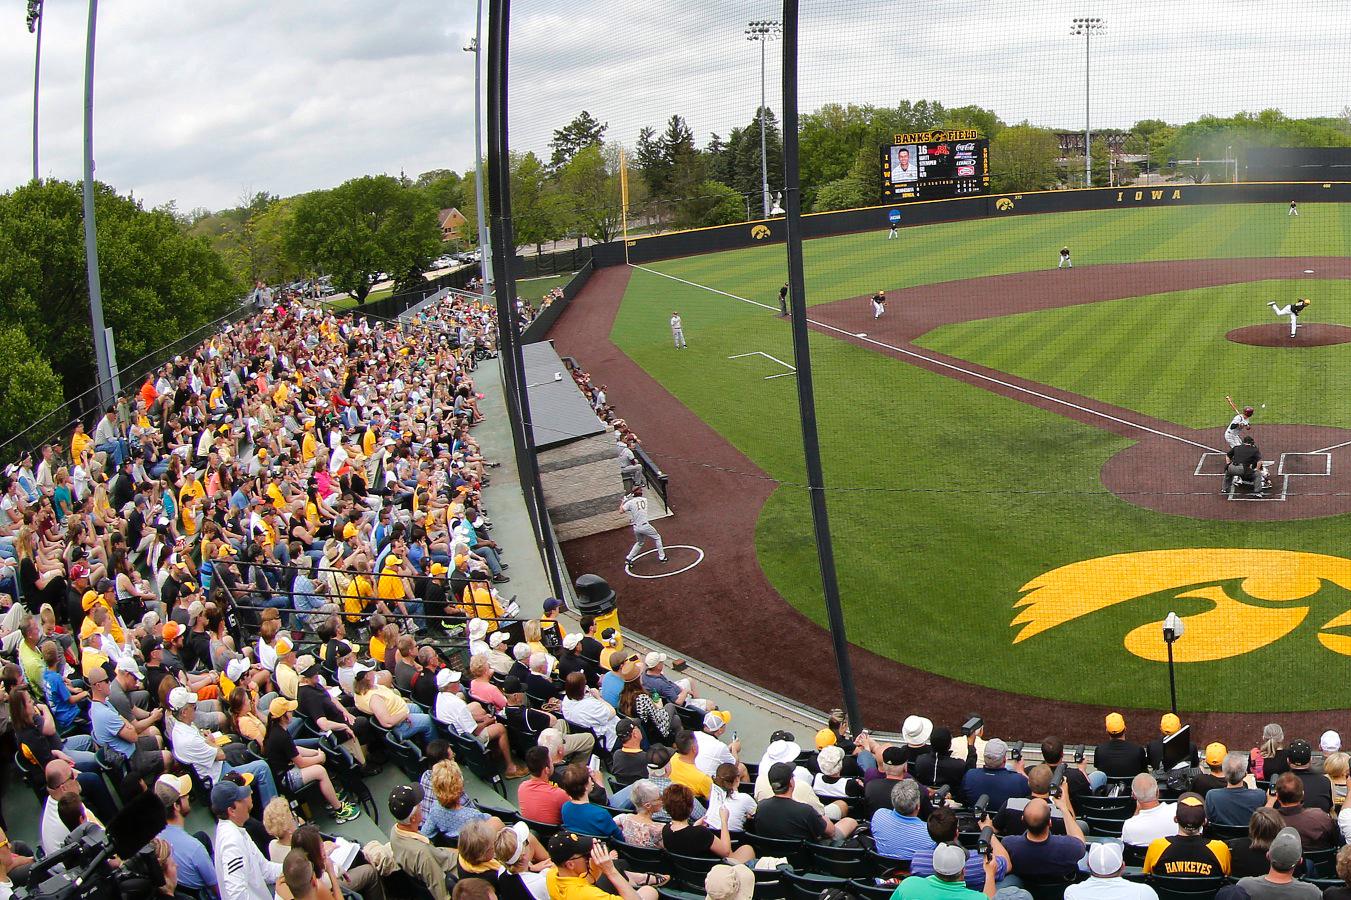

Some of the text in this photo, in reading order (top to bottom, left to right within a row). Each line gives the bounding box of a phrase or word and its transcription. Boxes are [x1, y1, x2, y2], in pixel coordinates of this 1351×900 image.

[895, 130, 977, 144] BANKS FIELD
[918, 145, 928, 154] 16
[1117, 190, 1181, 201] IOWA
[1164, 860, 1212, 876] HAWKEYES
